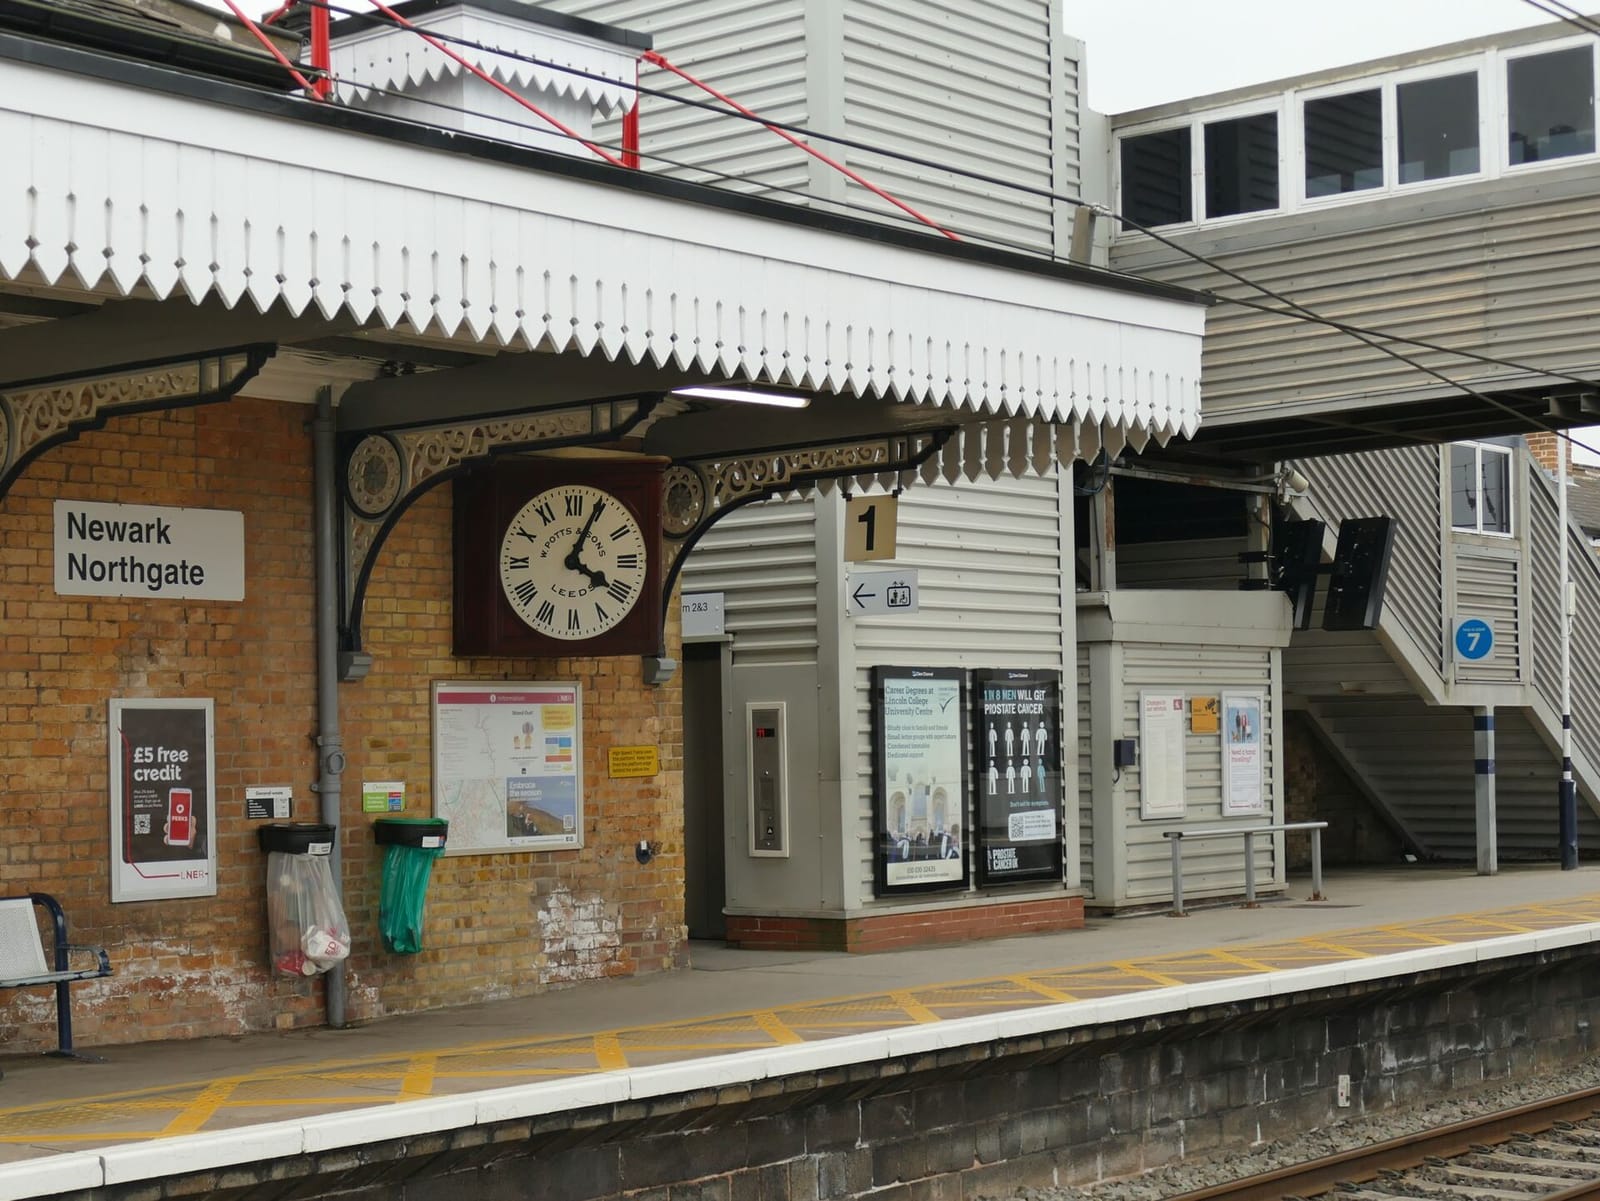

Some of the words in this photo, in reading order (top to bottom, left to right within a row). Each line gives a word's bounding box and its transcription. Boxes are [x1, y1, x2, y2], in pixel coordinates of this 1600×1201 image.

[67, 511, 171, 544] Newark
[858, 505, 876, 551] 1
[585, 530, 606, 557] SONS
[67, 552, 205, 591] Northgate
[551, 583, 596, 598] LEEDS
[691, 602, 709, 612] 2&3
[1467, 632, 1481, 652] 7
[885, 686, 904, 695] Career
[905, 686, 927, 696] Degrees
[927, 687, 934, 695] at
[984, 689, 988, 701] 1
[988, 689, 995, 701] IN
[995, 689, 1001, 701] 8
[1001, 689, 1017, 700] MEN
[1017, 689, 1032, 700] WILL
[1033, 689, 1046, 700] GET
[885, 696, 908, 705] Lincoln
[908, 696, 929, 706] College
[885, 707, 914, 716] University
[915, 707, 933, 716] Centre
[984, 703, 1016, 715] PROSTATE
[1017, 703, 1044, 714] CANCER
[133, 746, 154, 764] £5
[157, 746, 189, 763] free
[133, 764, 182, 781] credit
[171, 815, 189, 823] PERKS
[992, 848, 1016, 860] PROSTATE
[180, 870, 205, 880] LNER
